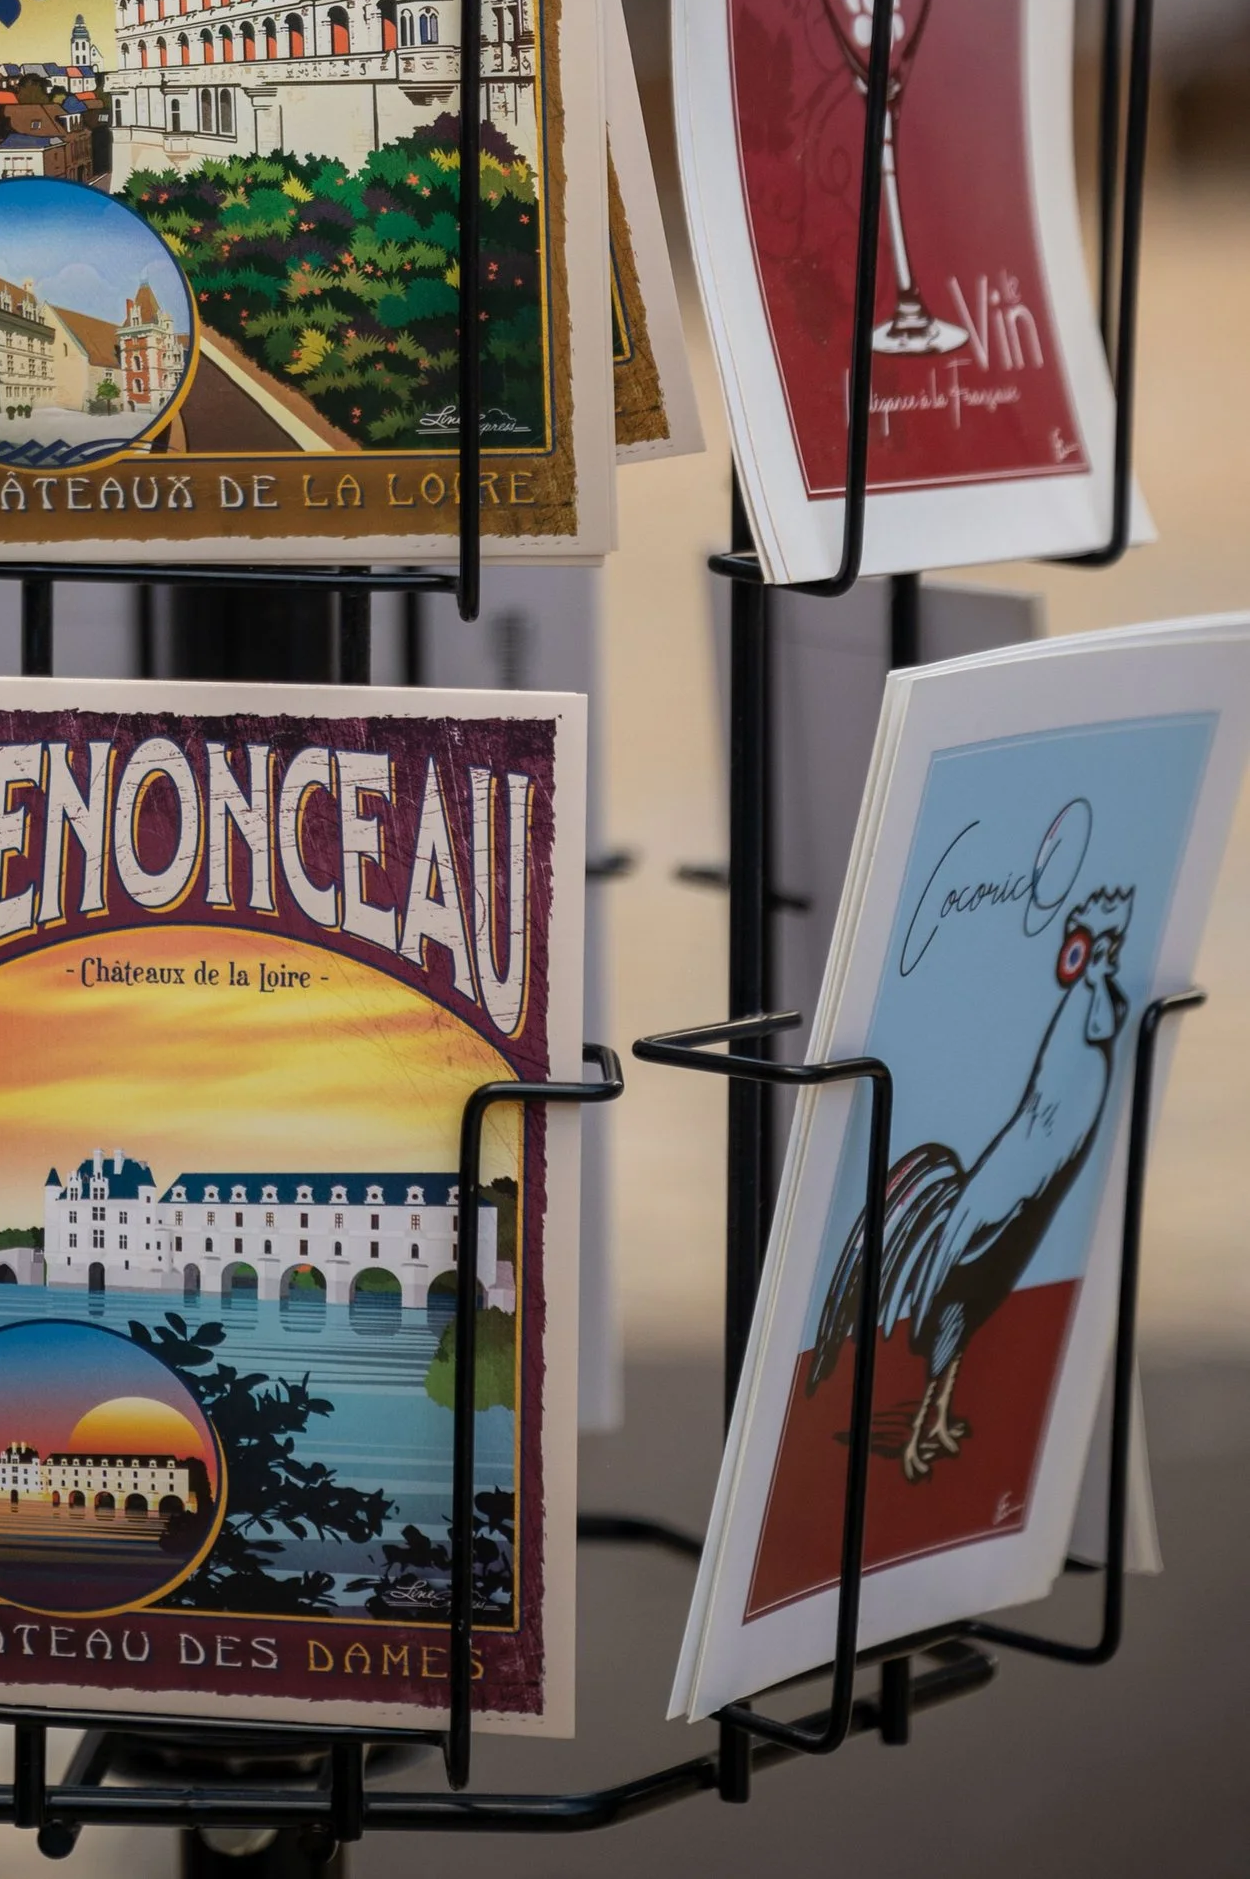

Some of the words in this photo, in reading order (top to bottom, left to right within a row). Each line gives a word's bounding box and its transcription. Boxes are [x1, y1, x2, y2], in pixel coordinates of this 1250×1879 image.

[949, 274, 1045, 371] Vin
[220, 474, 279, 509] DE
[302, 473, 363, 508] LA
[81, 957, 185, 988] Châteaux
[193, 960, 220, 986] de
[229, 961, 250, 987] la
[259, 962, 311, 993] Loire
[179, 1632, 279, 1670] DES
[307, 1639, 485, 1680] DAMES
